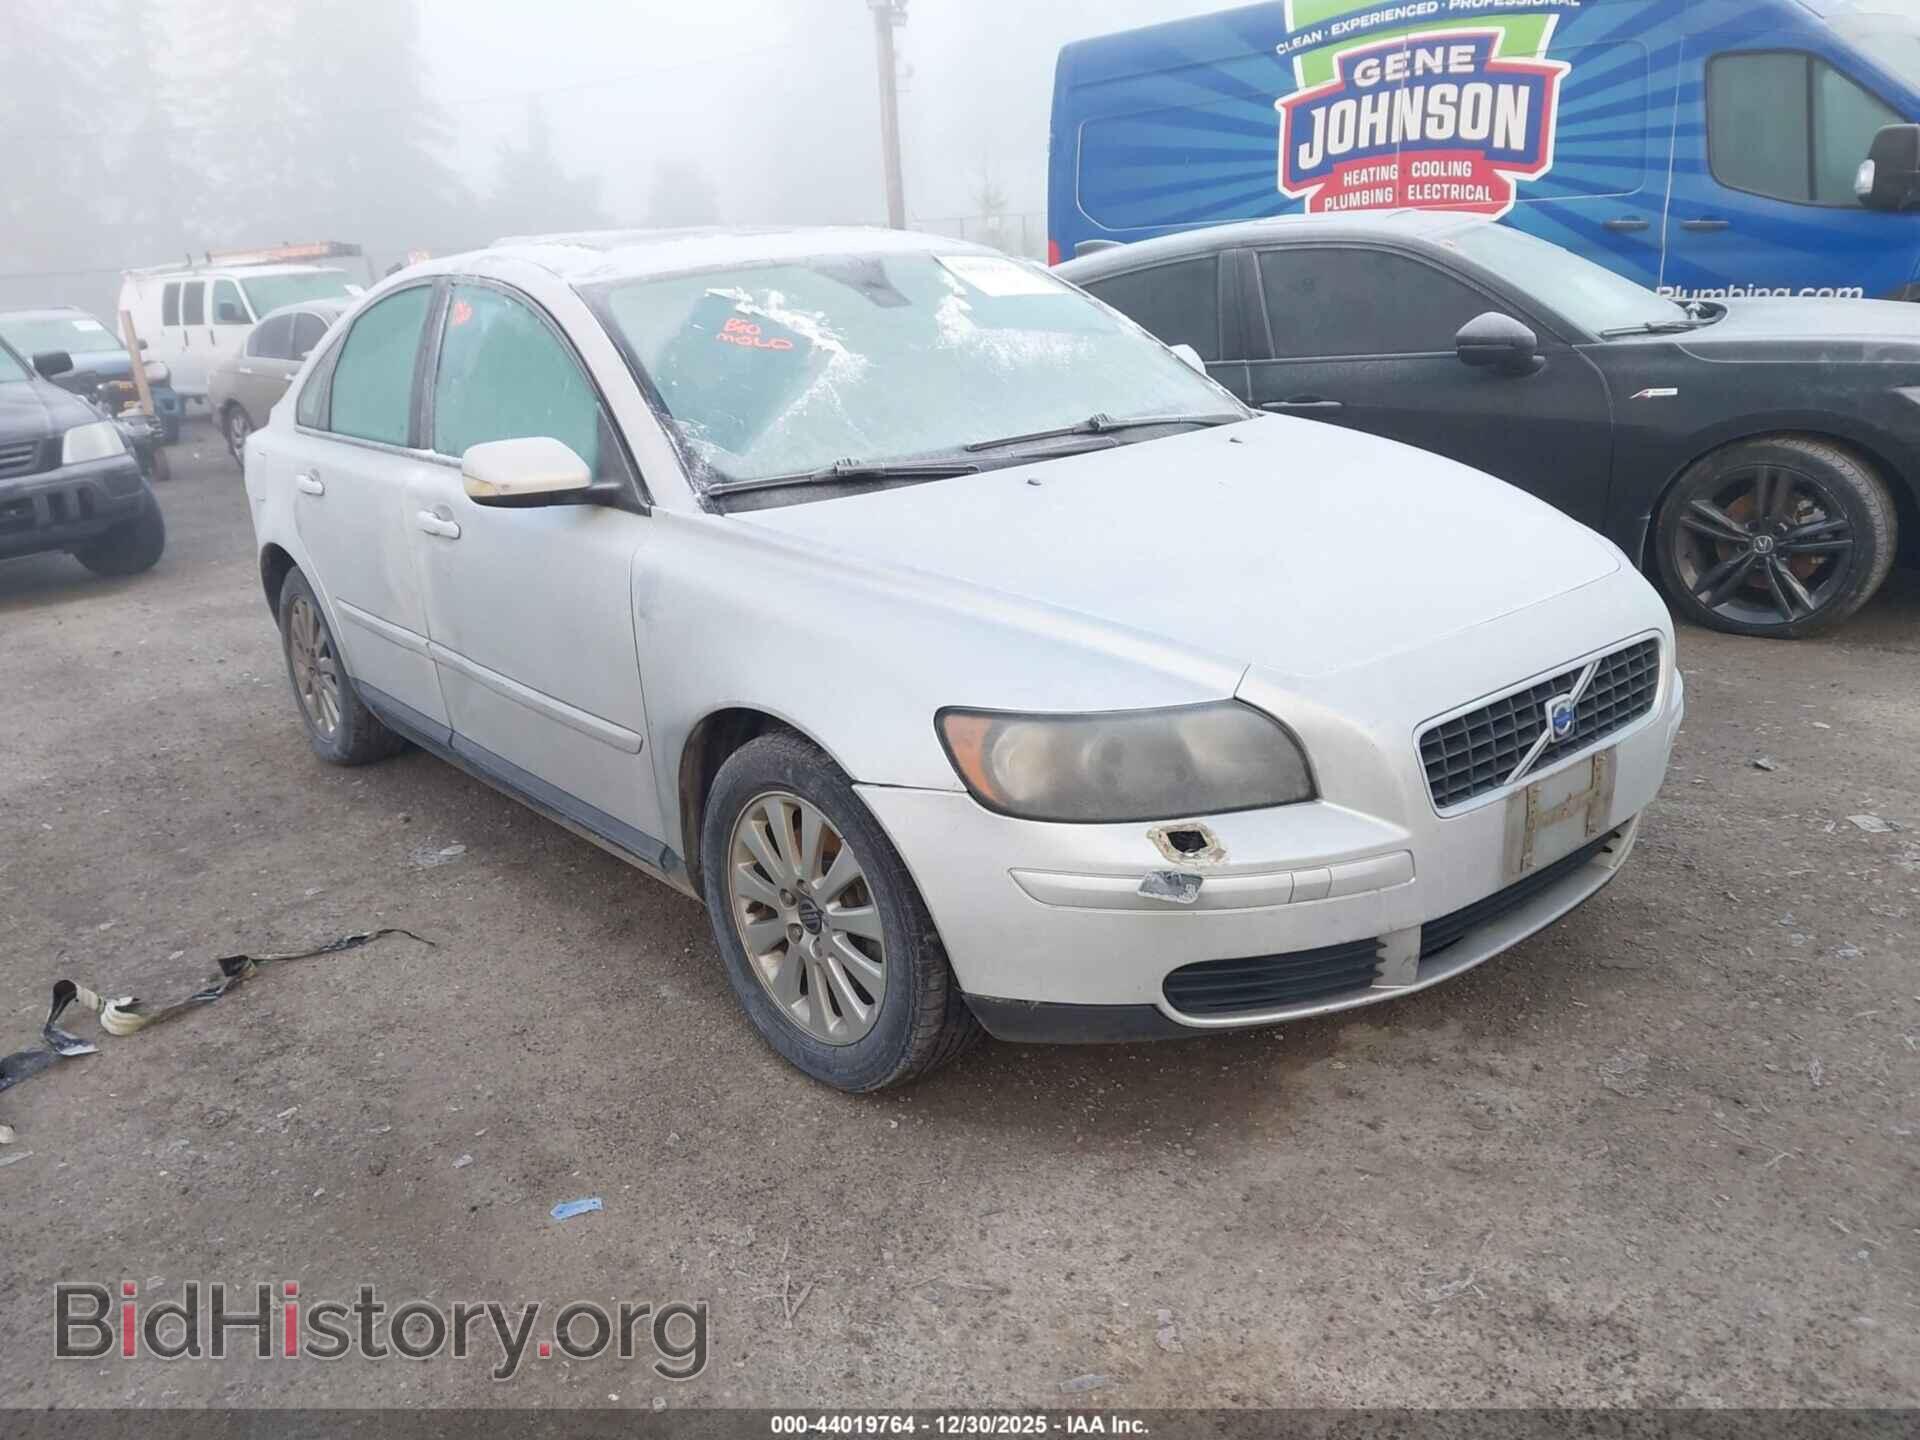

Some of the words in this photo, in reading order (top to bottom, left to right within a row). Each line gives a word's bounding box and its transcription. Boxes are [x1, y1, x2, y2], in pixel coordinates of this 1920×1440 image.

[1276, 29, 1322, 55] CLEAN
[1331, 1, 1439, 36] EXPERIENCED
[1353, 44, 1476, 88] GENE
[1298, 82, 1530, 171] JOHNSON
[1343, 164, 1399, 186] HEATING
[1411, 160, 1472, 178] COOLING
[1324, 187, 1393, 212] PLUMBING
[1407, 183, 1493, 202] ELECTRICAL
[1656, 283, 1864, 298] Plumbincom
